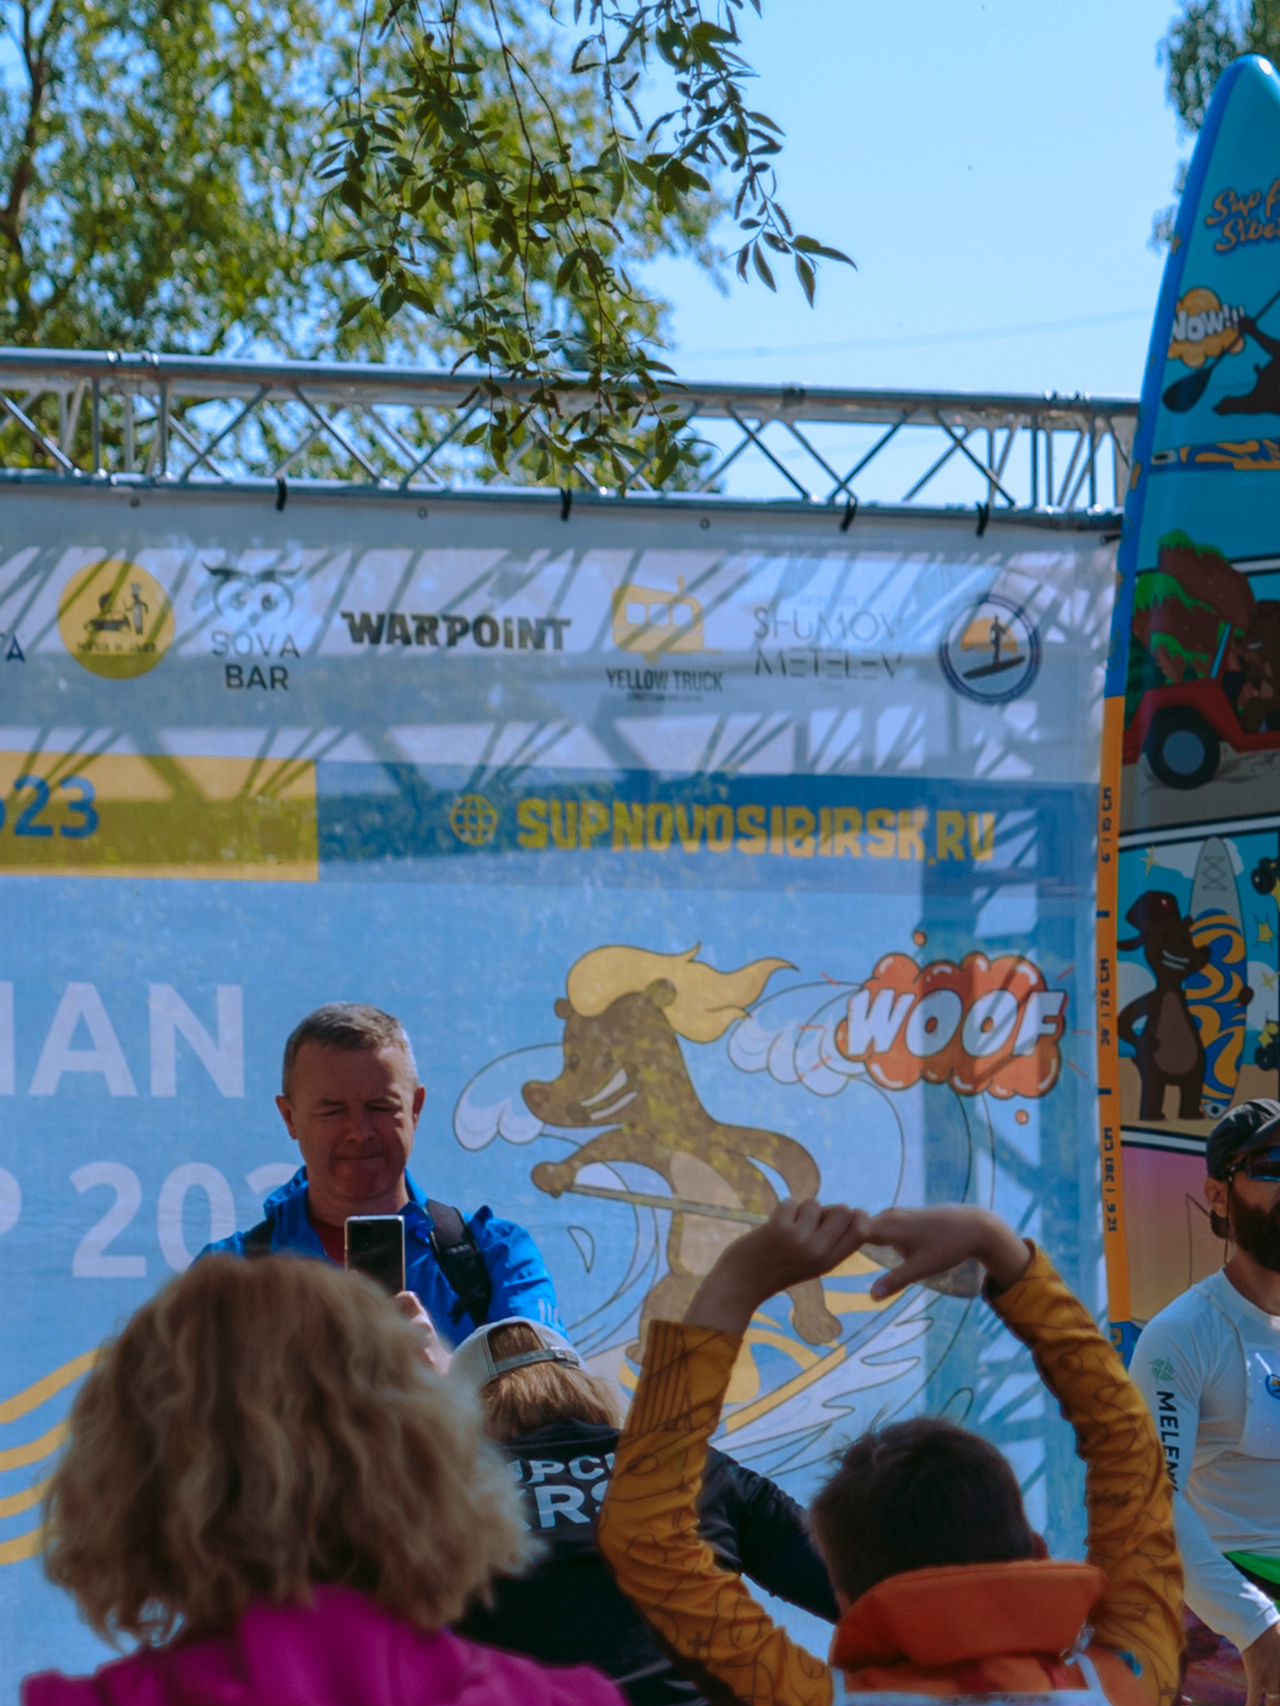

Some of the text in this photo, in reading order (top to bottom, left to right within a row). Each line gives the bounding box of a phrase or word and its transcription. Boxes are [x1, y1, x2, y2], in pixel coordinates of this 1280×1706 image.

[1205, 189, 1262, 226] Sup
[212, 630, 300, 659] SOVA
[341, 611, 573, 651] WARPOINT
[225, 664, 289, 691] BAR
[605, 668, 723, 693] YELLOW TRUCK
[0, 774, 99, 839] 23
[516, 797, 996, 866] SUPNOVOSIBIRSK.RU
[847, 987, 1068, 1058] WOOF
